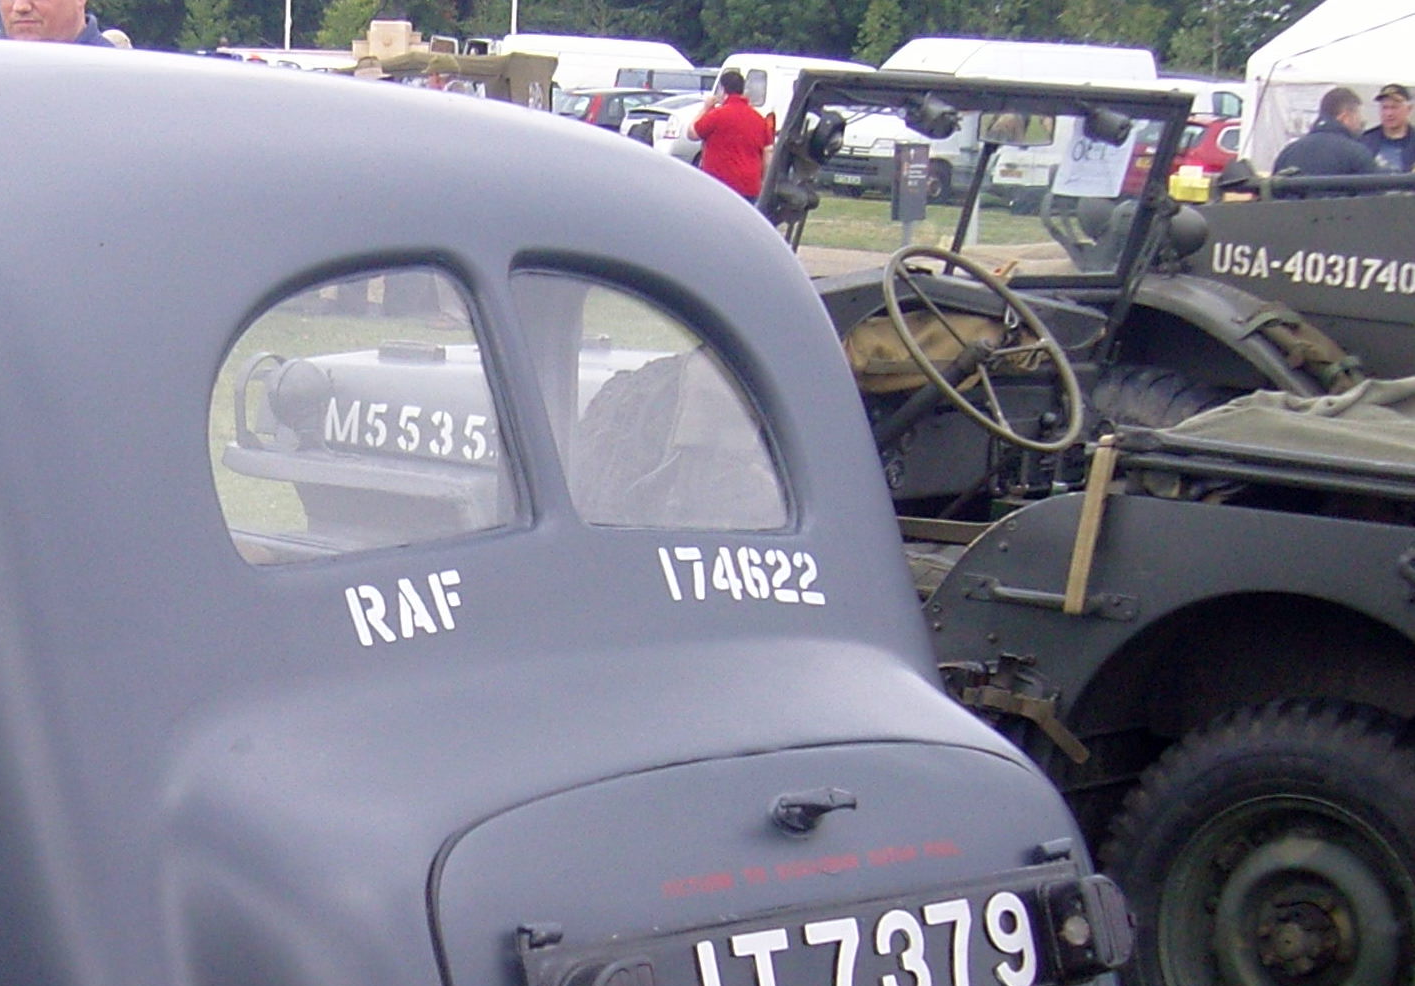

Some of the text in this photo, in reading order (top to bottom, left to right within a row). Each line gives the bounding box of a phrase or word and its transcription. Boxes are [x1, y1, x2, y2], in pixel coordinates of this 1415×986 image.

[1211, 242, 1415, 294] USA-4031740
[325, 397, 499, 460] M5535
[658, 546, 826, 605] 174622
[345, 569, 461, 647] RAF
